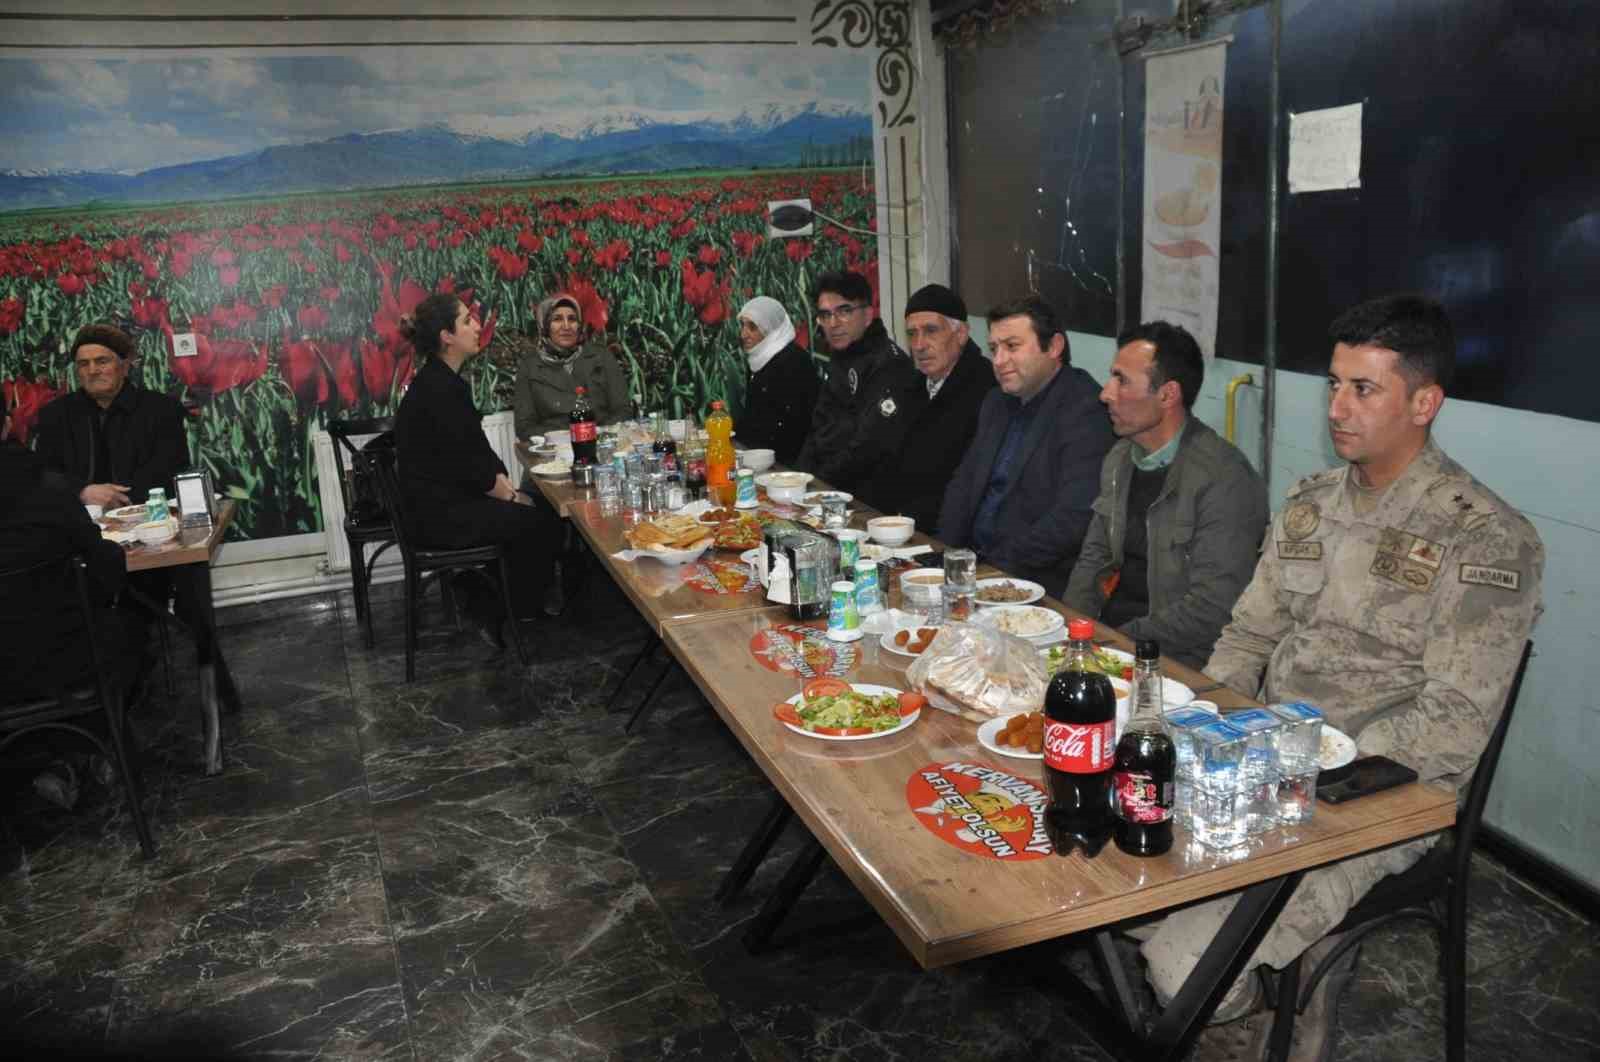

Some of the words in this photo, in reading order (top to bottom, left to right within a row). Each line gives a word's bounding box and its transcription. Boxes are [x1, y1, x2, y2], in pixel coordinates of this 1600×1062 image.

[1465, 567, 1515, 587] JANDARMA
[1046, 722, 1092, 758] Cola
[961, 811, 1018, 858] OLSUN
